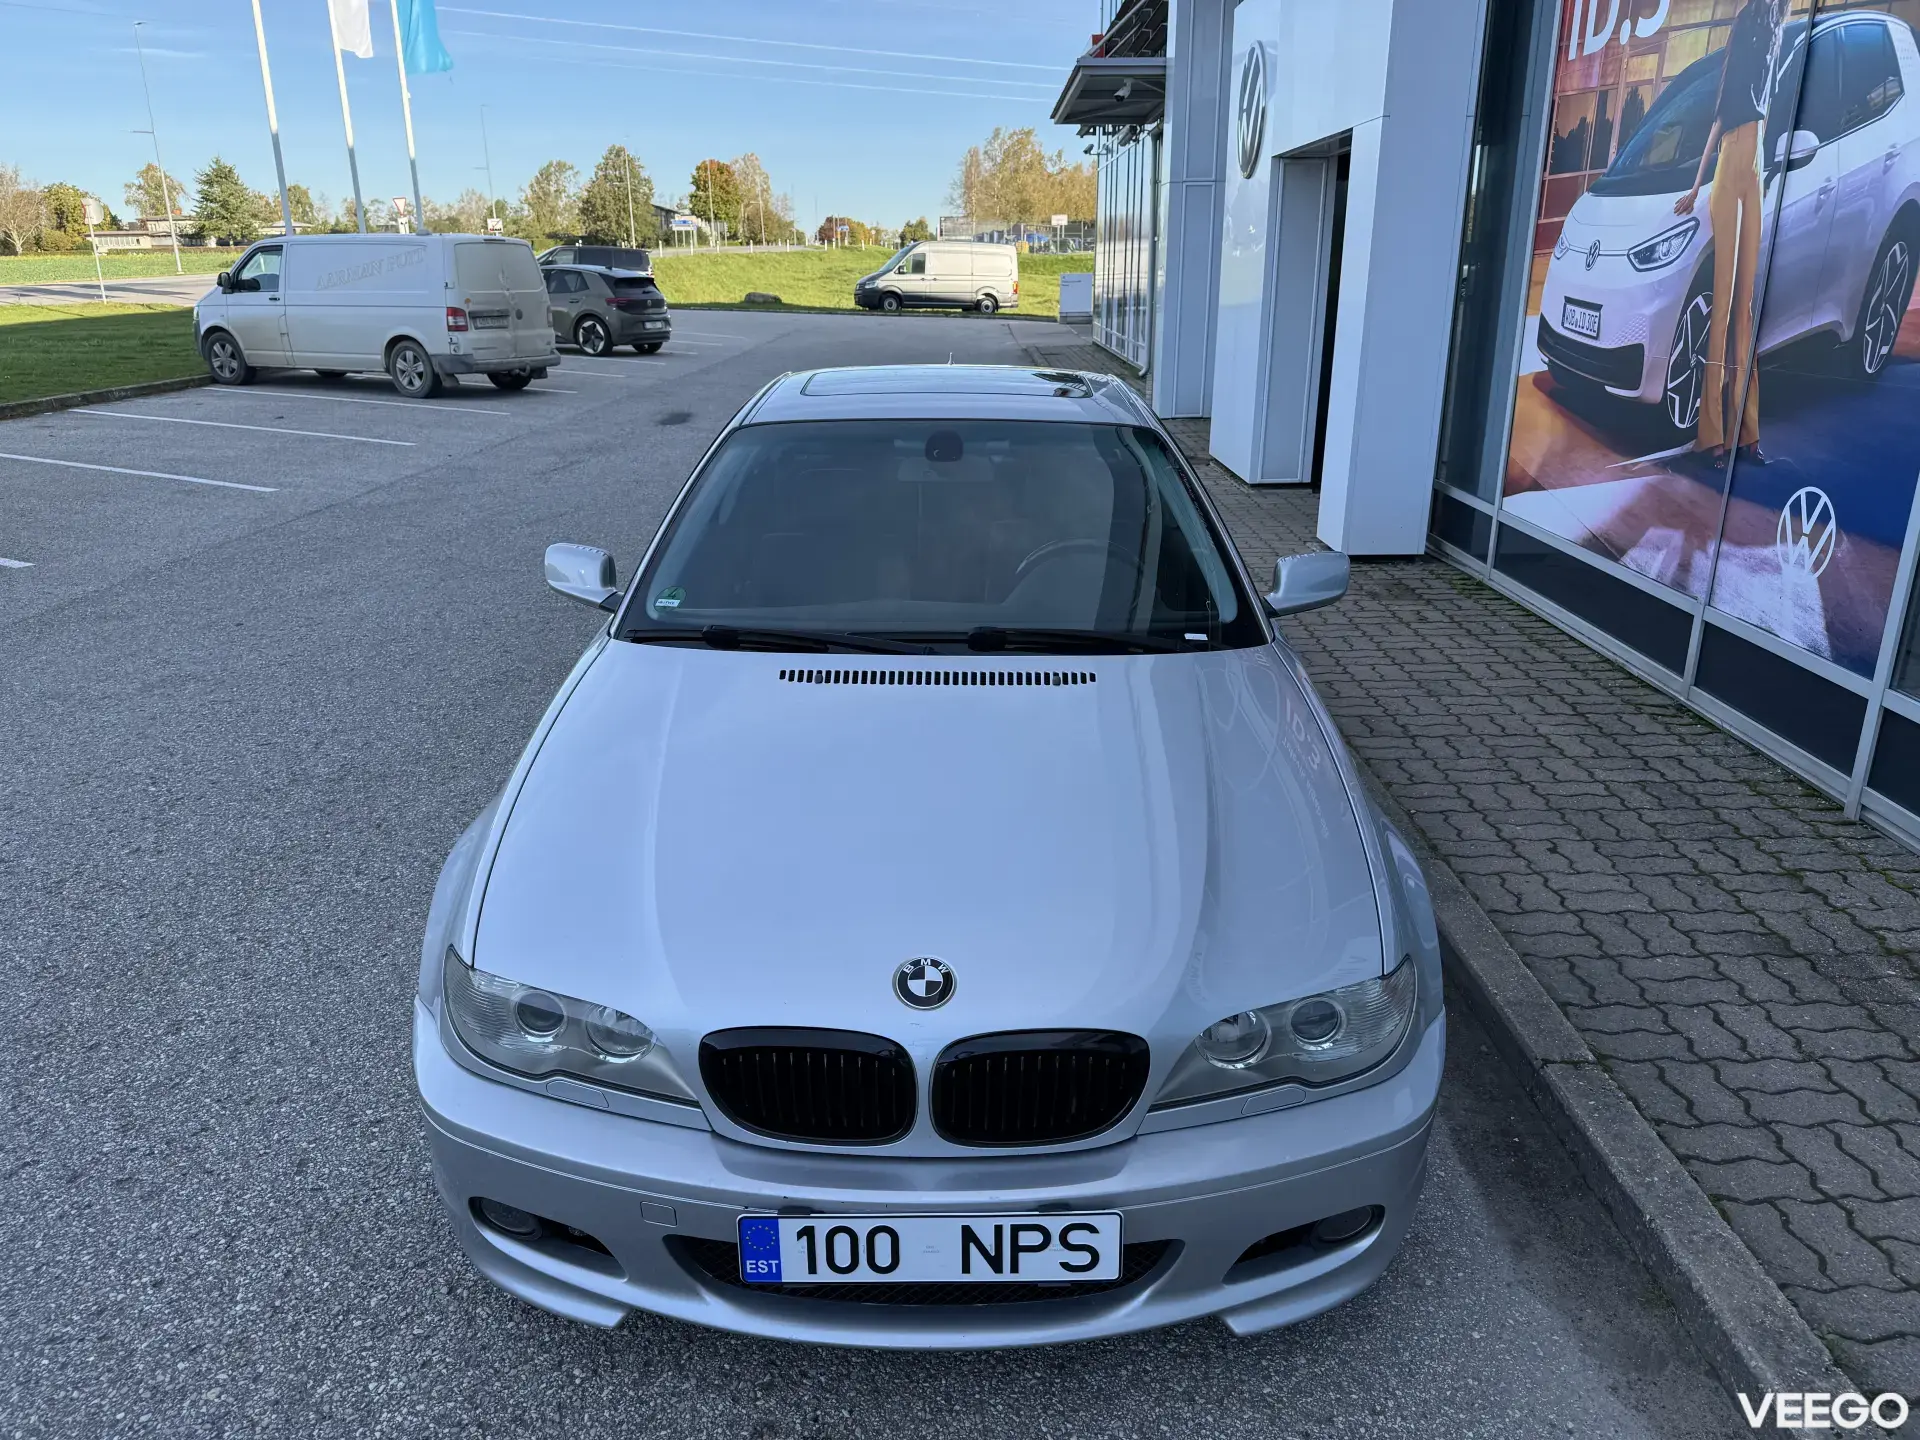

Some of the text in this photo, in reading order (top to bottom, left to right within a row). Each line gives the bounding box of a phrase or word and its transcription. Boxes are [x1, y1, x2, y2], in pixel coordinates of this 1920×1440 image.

[903, 958, 950, 974] BMW
[796, 1222, 1100, 1275] 100 NPS
[746, 1260, 780, 1274] EST
